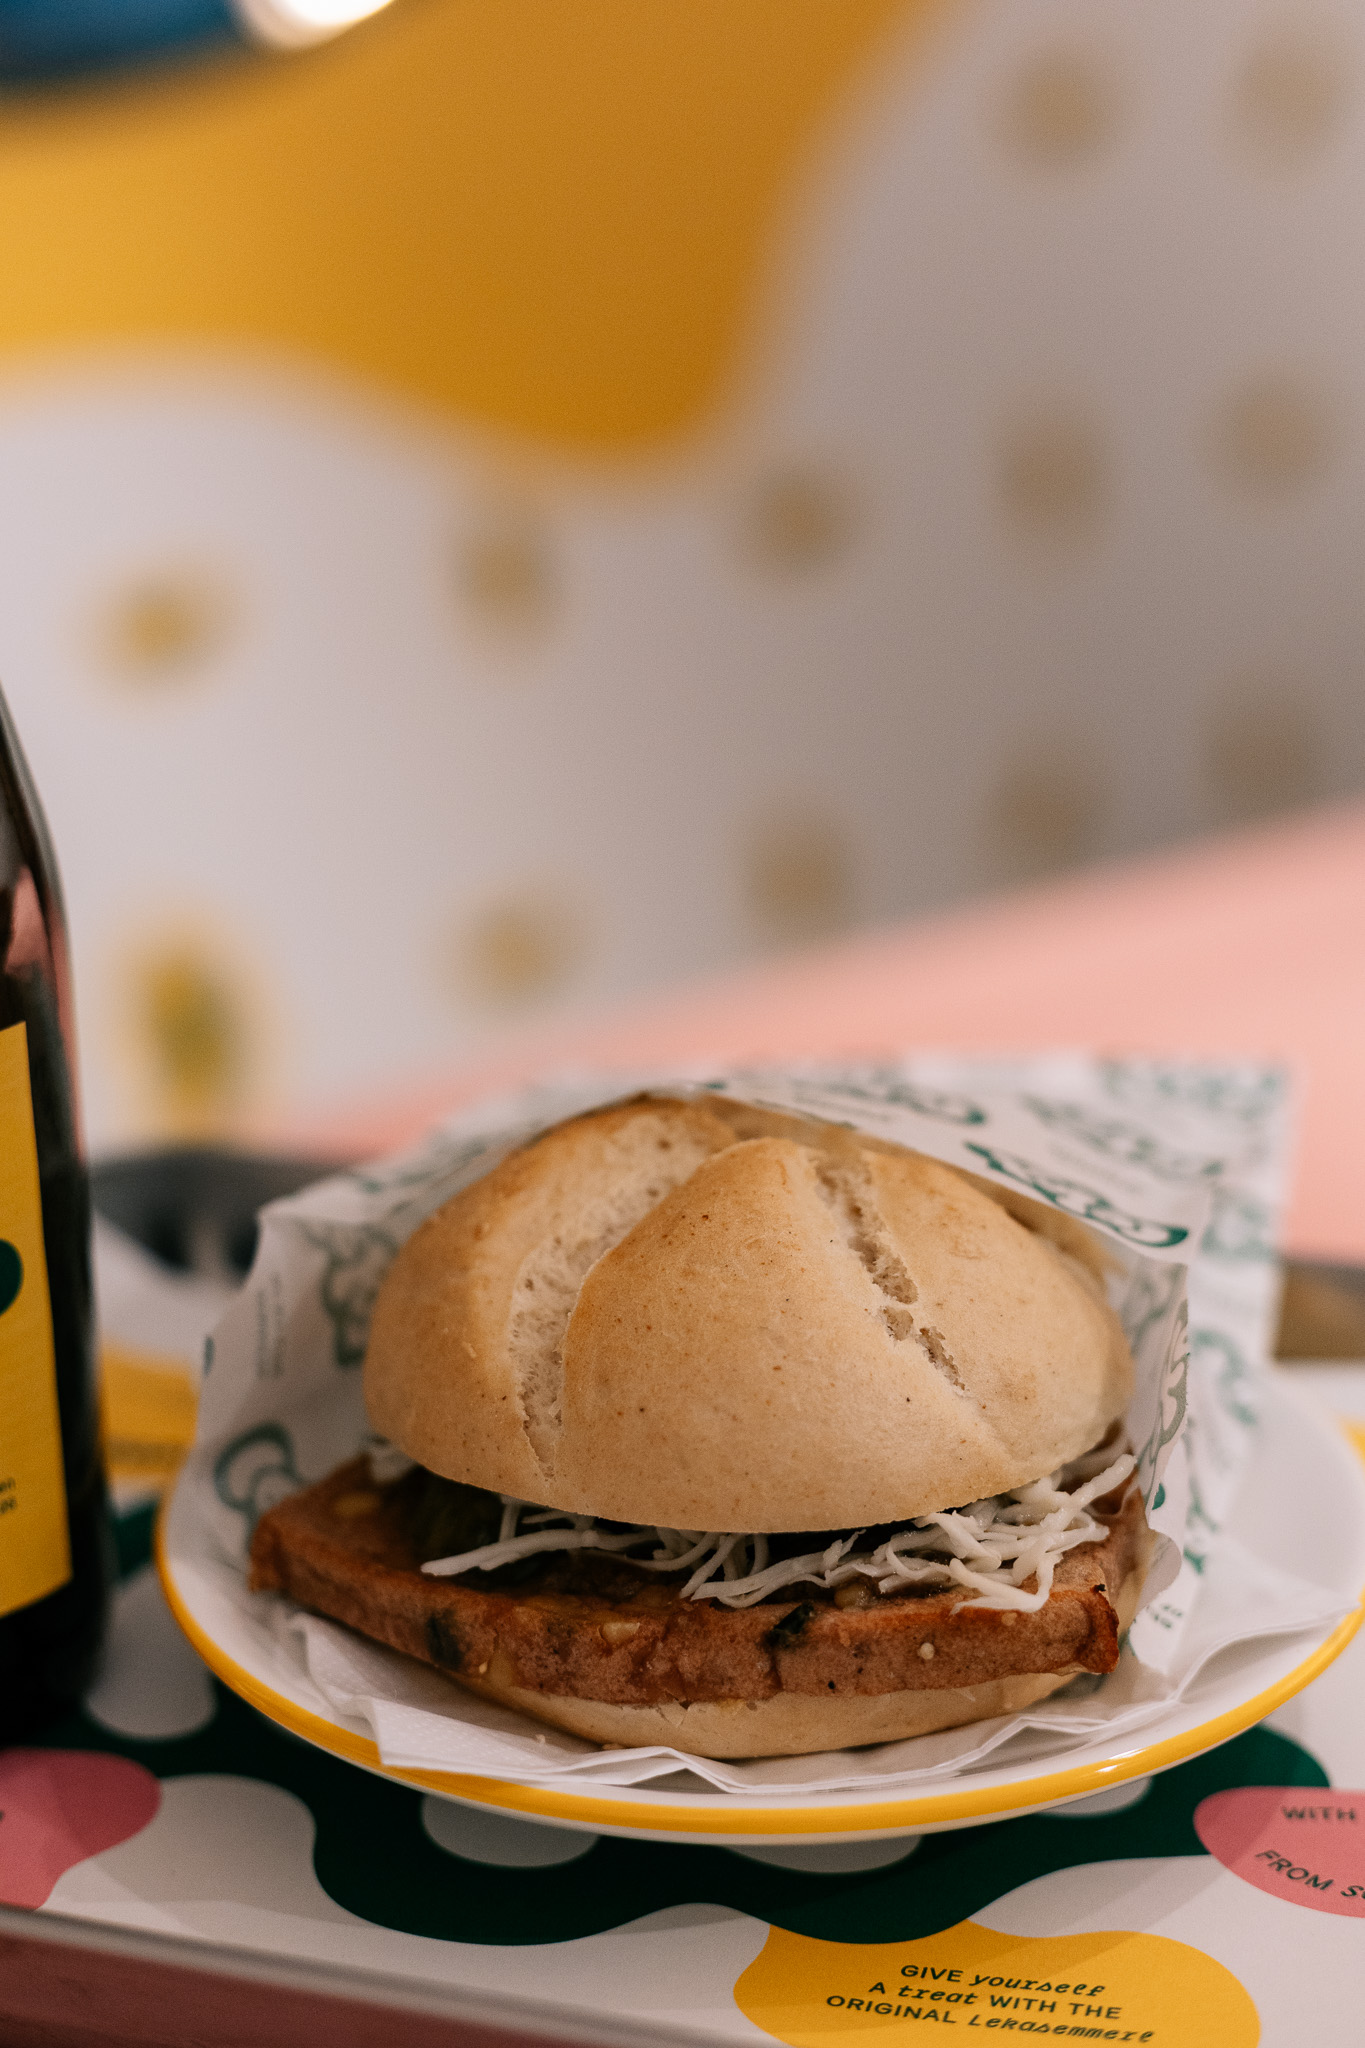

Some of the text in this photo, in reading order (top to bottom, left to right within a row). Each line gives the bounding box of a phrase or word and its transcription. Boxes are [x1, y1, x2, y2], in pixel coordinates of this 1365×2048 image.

[1281, 1805, 1356, 1821] WITH
[1255, 1849, 1365, 1900] FROM S
[900, 1964, 1106, 1997] GIVE yourself
[826, 1995, 957, 2024] ORIGINAL
[868, 1981, 1123, 2020] A treat WITH THE
